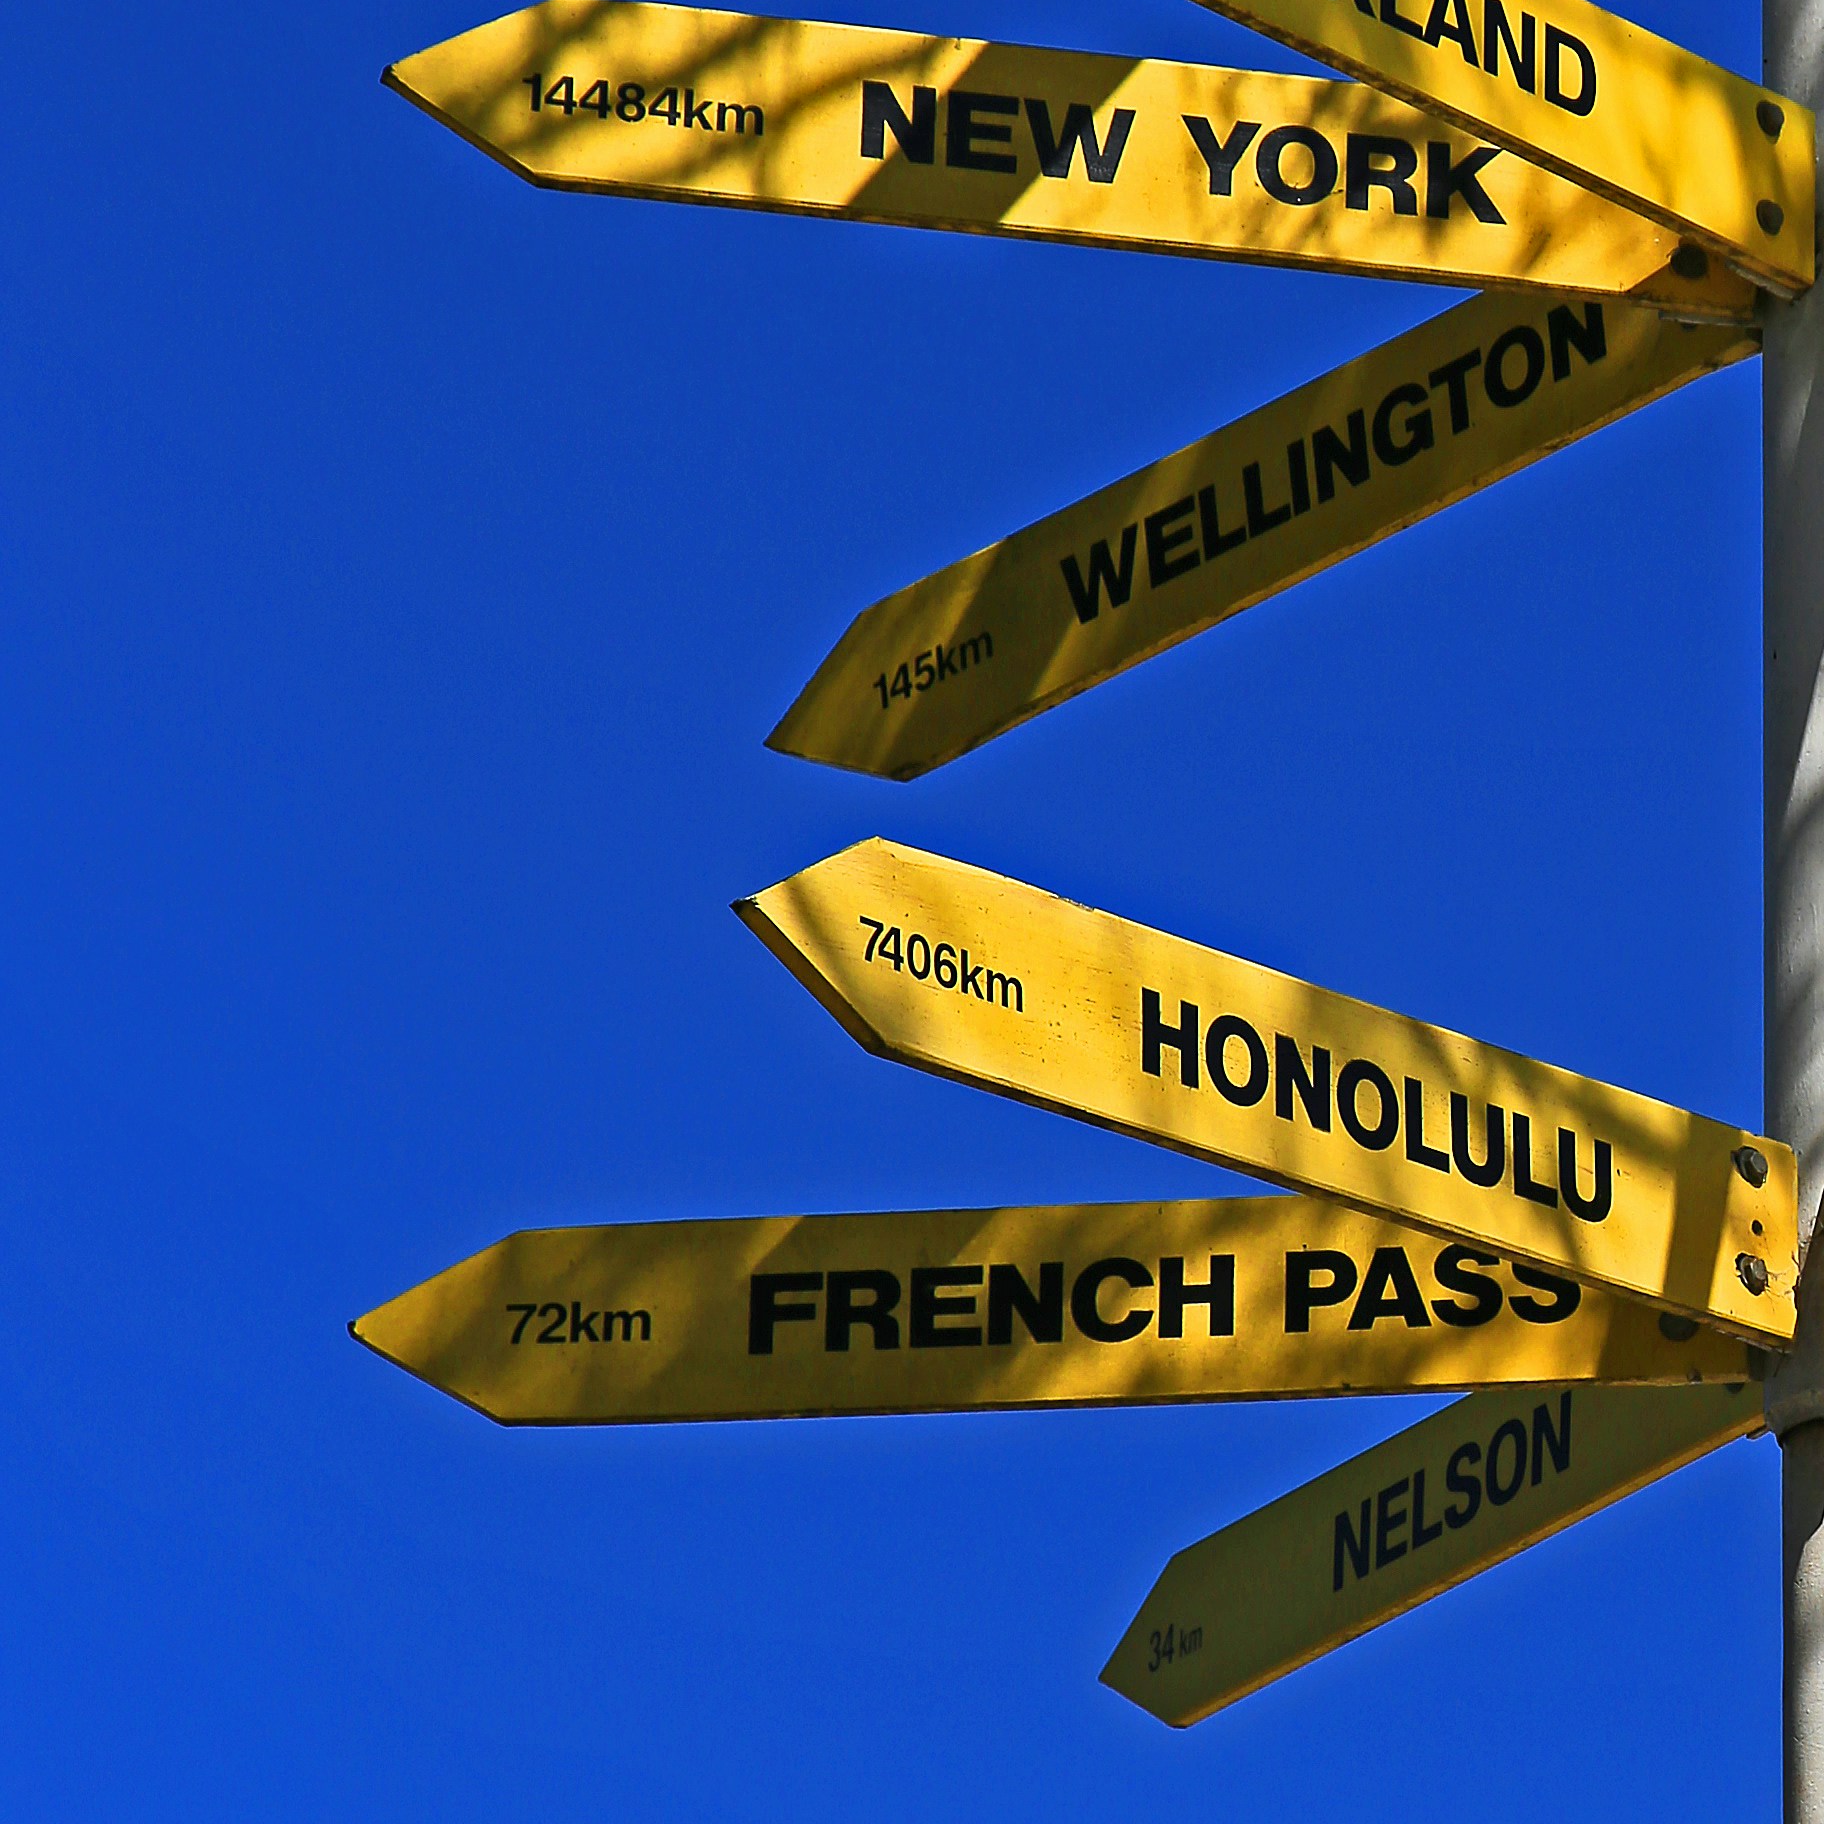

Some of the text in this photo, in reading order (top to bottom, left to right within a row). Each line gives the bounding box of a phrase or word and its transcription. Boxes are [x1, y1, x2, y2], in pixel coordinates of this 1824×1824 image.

[521, 72, 1507, 224] 14484km NEW YORK
[873, 303, 1608, 710] 145km WELLINGTON
[859, 914, 1612, 1223] 7406km HONOLULU
[506, 1244, 1581, 1356] 72km FRENCH PASS
[1148, 1623, 1174, 1673] 34
[1333, 1391, 1571, 1592] NELSON
